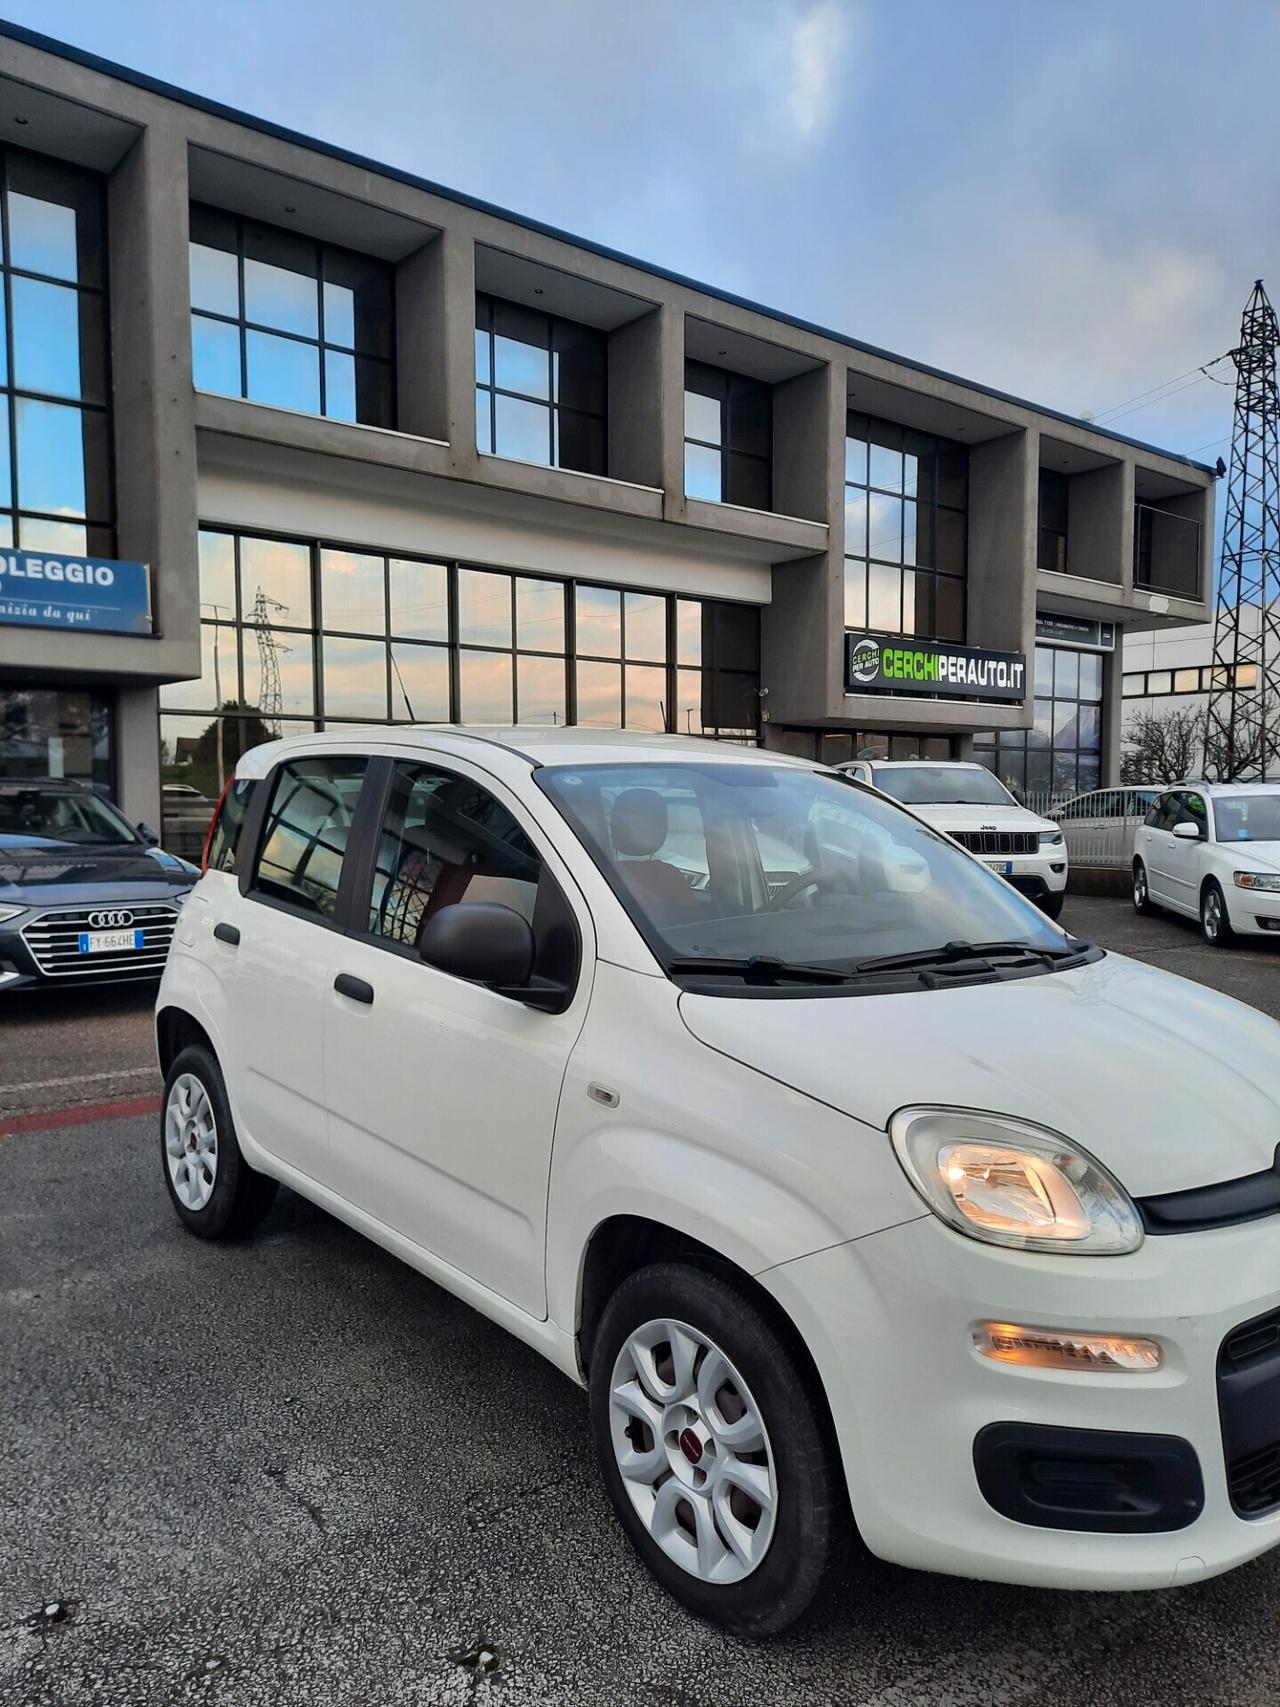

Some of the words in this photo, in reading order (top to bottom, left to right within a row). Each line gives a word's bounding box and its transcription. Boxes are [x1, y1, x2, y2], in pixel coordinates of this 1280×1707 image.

[43, 604, 61, 618] da
[852, 649, 880, 664] CERCHI
[852, 662, 864, 672] PER
[864, 657, 880, 668] AUTO
[882, 648, 1024, 689] CERCHIPERAUTO.IT
